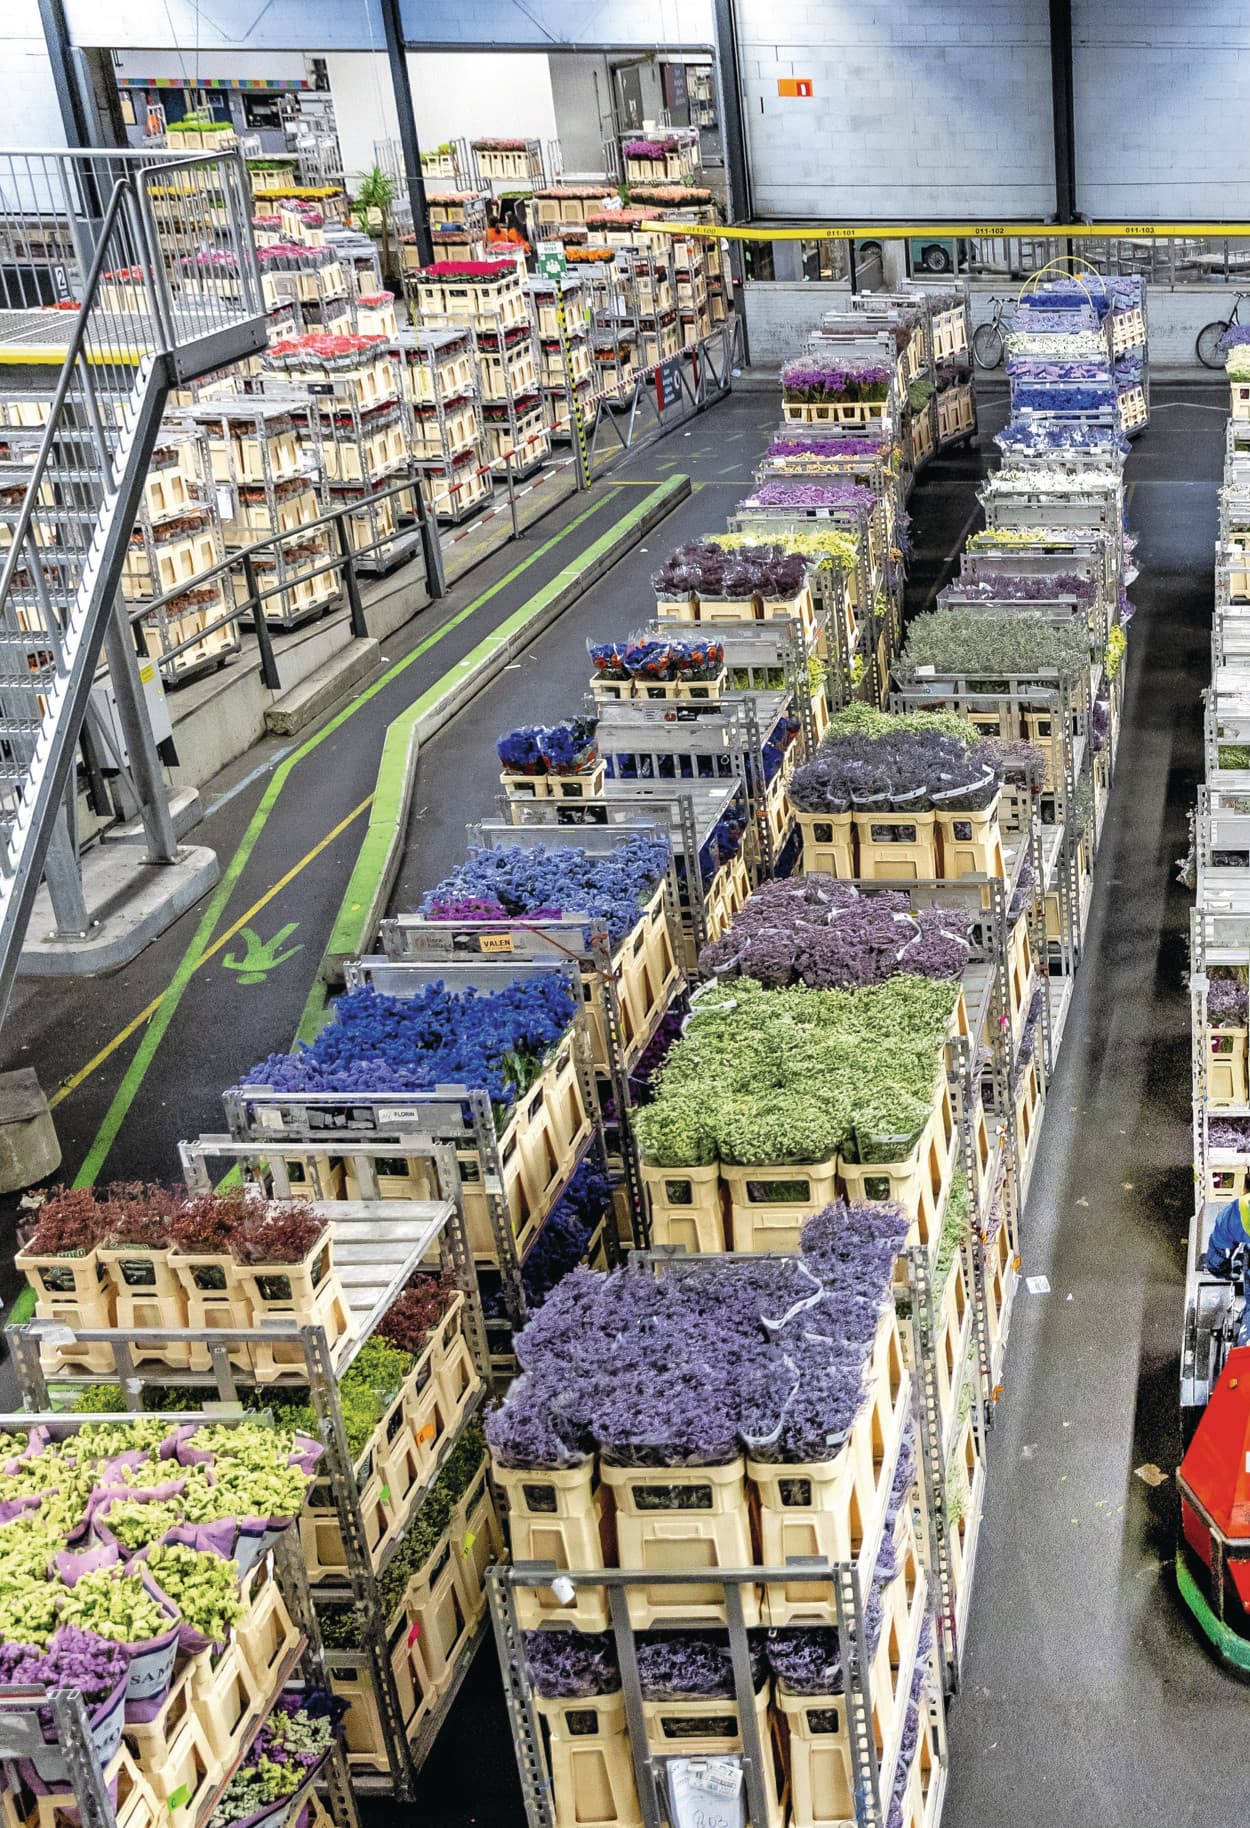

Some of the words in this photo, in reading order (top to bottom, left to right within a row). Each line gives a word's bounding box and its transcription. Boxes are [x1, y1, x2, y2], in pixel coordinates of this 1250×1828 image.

[826, 229, 856, 237] 011-101
[974, 227, 1005, 235] 011-102
[57, 269, 66, 287] 2
[483, 939, 511, 947] VALEN
